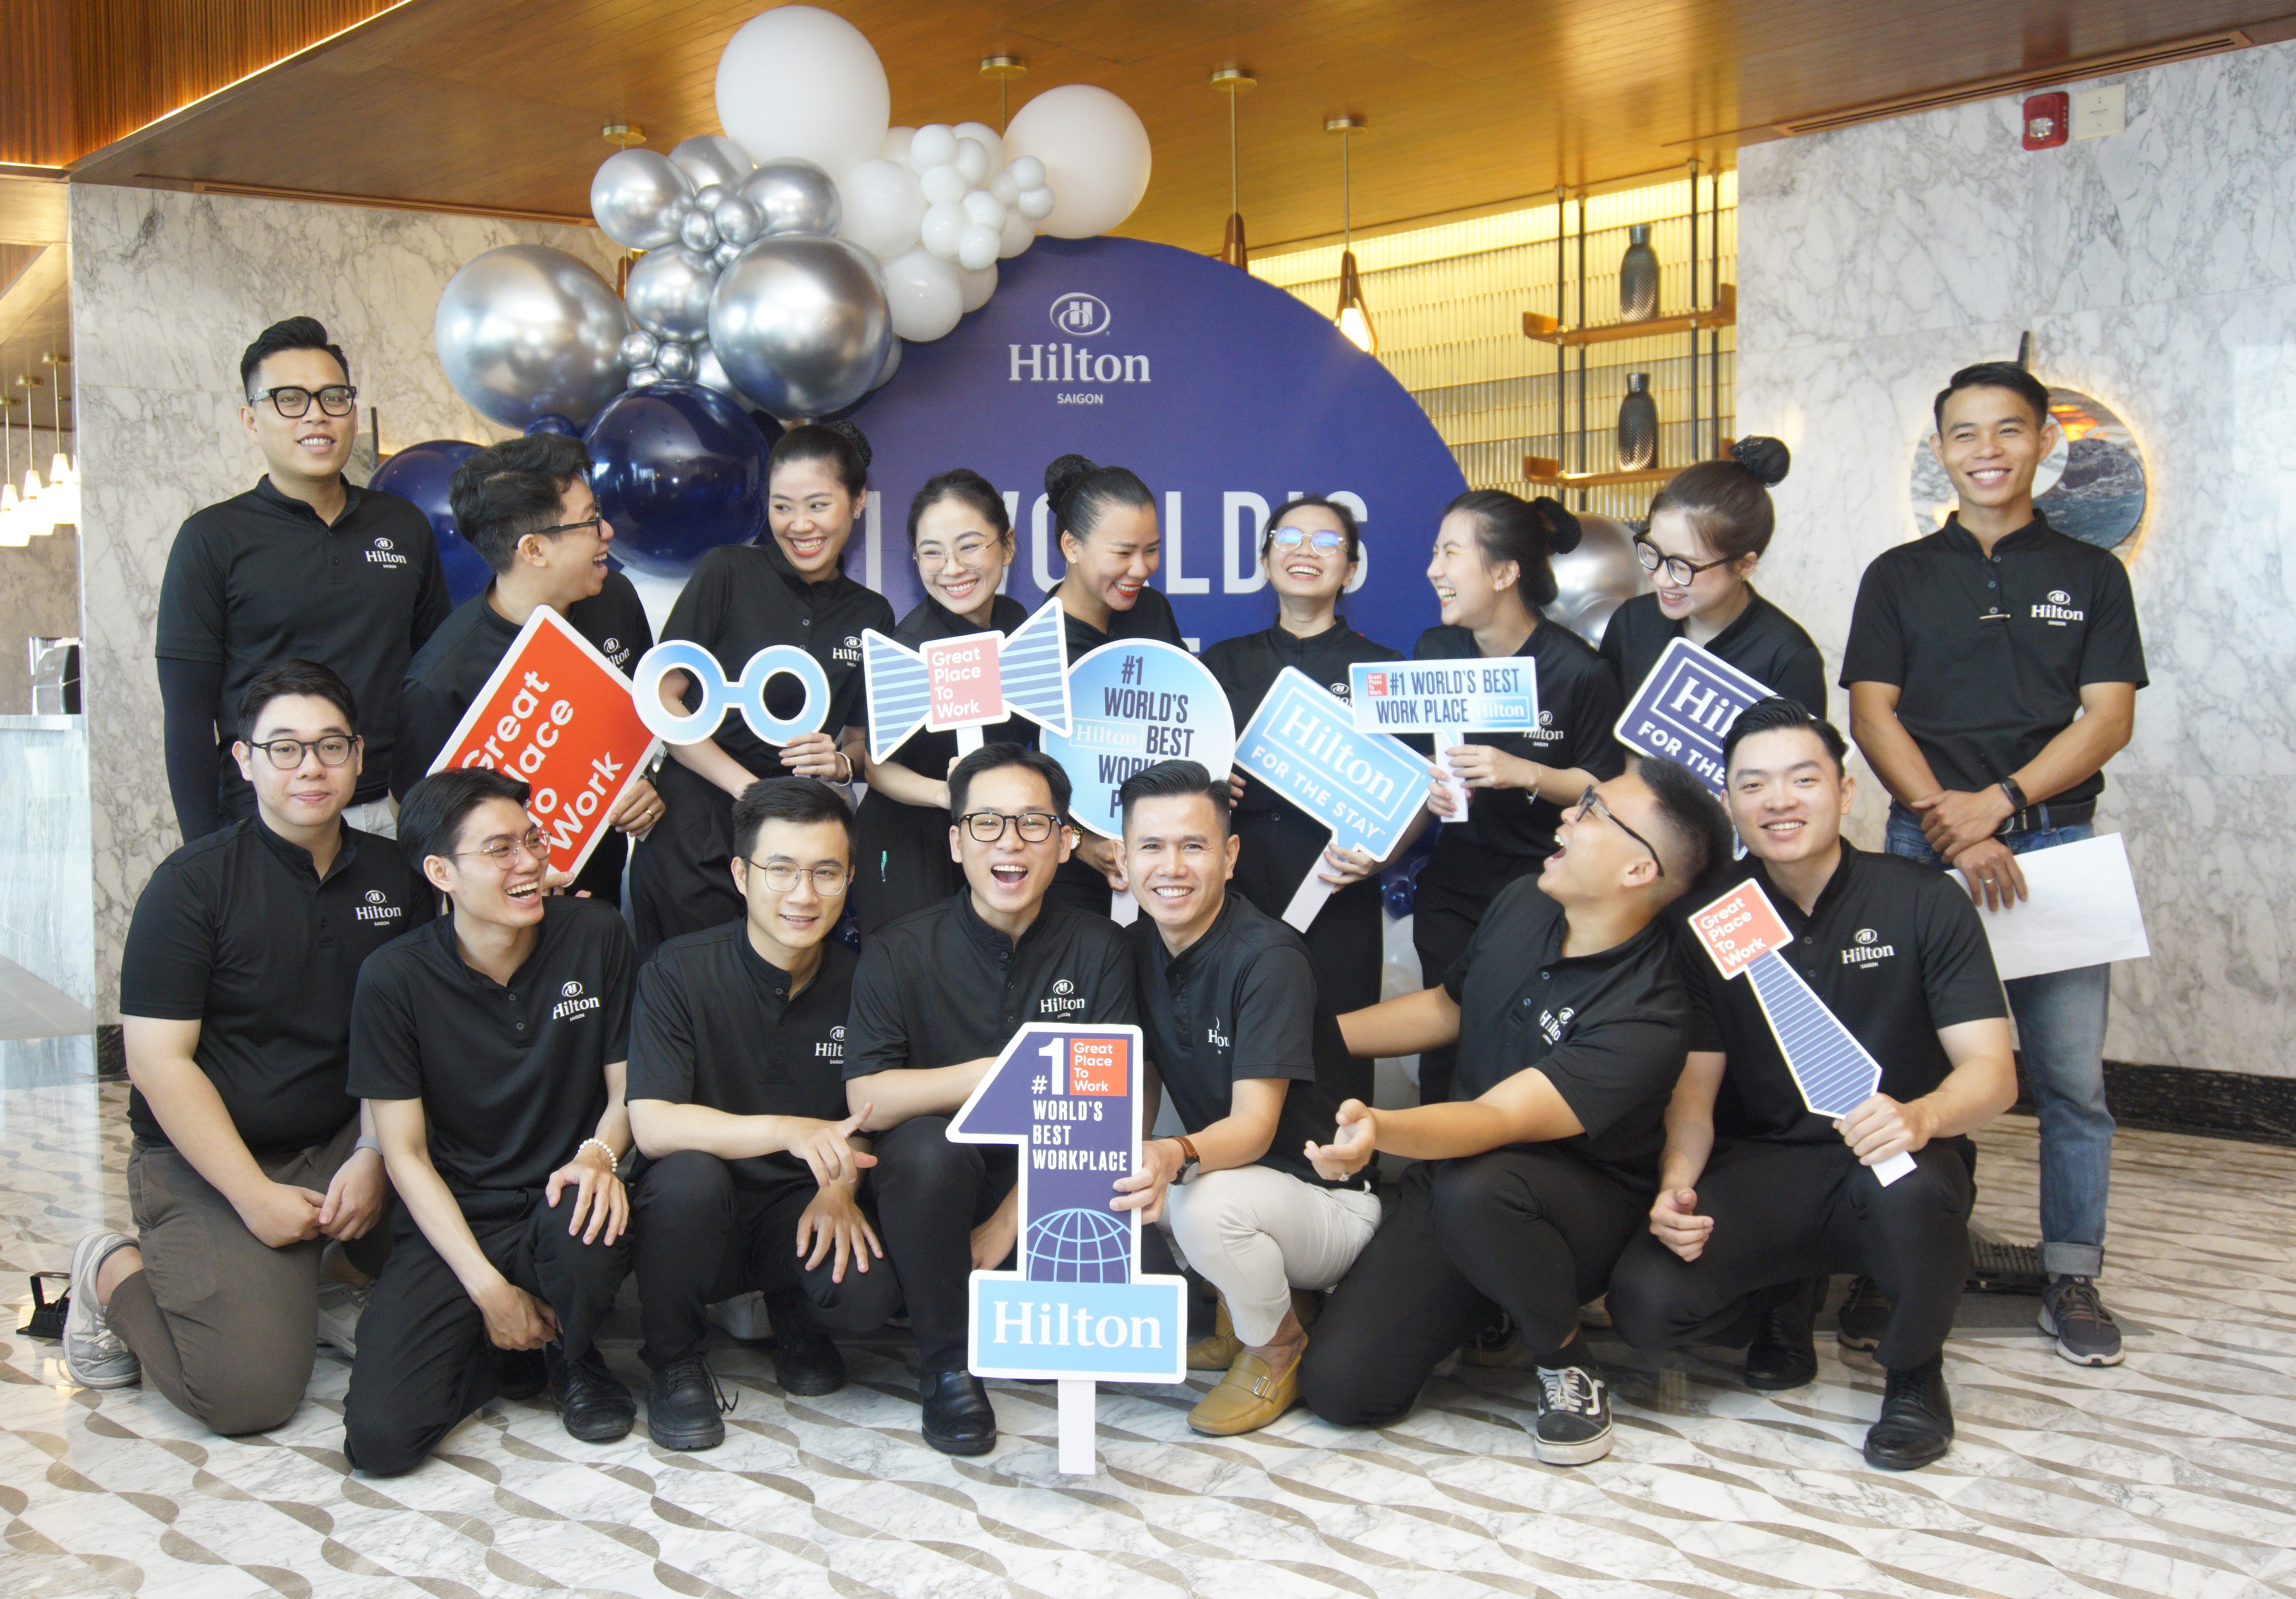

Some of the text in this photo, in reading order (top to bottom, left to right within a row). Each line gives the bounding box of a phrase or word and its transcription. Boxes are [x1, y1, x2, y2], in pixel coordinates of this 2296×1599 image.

[1009, 343, 1151, 382] Hilton
[1057, 393, 1104, 404] SAIGON
[364, 550, 407, 564] Hilton
[2031, 604, 2084, 621] Hilton
[931, 646, 981, 666] Great
[934, 666, 981, 684] Place
[1121, 655, 1144, 685] #1
[1390, 668, 1519, 696] #1 WORLD'S BEST
[934, 686, 953, 701] To
[1104, 686, 1189, 723] WORLD'S
[936, 699, 980, 718] Work
[1376, 699, 1420, 724] WORK
[1424, 698, 1469, 723] PLACE
[1477, 702, 1525, 718] Hilton
[1671, 676, 1744, 738] Hil
[503, 700, 573, 783] lace
[1075, 724, 1195, 757] Hilton BEST
[1279, 704, 1395, 803] Hilton
[1638, 720, 1726, 786] FOR THE
[1251, 745, 1290, 779] FOR
[1293, 772, 1332, 807] THE
[355, 905, 402, 920] Hilton
[1701, 897, 1746, 929] Great
[1708, 911, 1753, 942] Place
[1715, 939, 1735, 954] To
[1723, 938, 1767, 967] Work
[1842, 945, 1895, 964] Hilton
[553, 997, 600, 1020] Hilton
[1040, 997, 1085, 1013] Hilton
[569, 1013, 585, 1022] SAIGON
[1540, 1009, 1561, 1041] Hilto
[1074, 1042, 1113, 1054] Great
[1031, 1037, 1064, 1095] #1
[1074, 1055, 1112, 1067] Place
[1074, 1067, 1089, 1078] To
[1074, 1080, 1109, 1092] Work
[1032, 1100, 1103, 1121] WORLD'S
[1032, 1124, 1071, 1145] BEST
[1032, 1149, 1127, 1171] WORKPLACE
[993, 1301, 1162, 1348] Hilton
